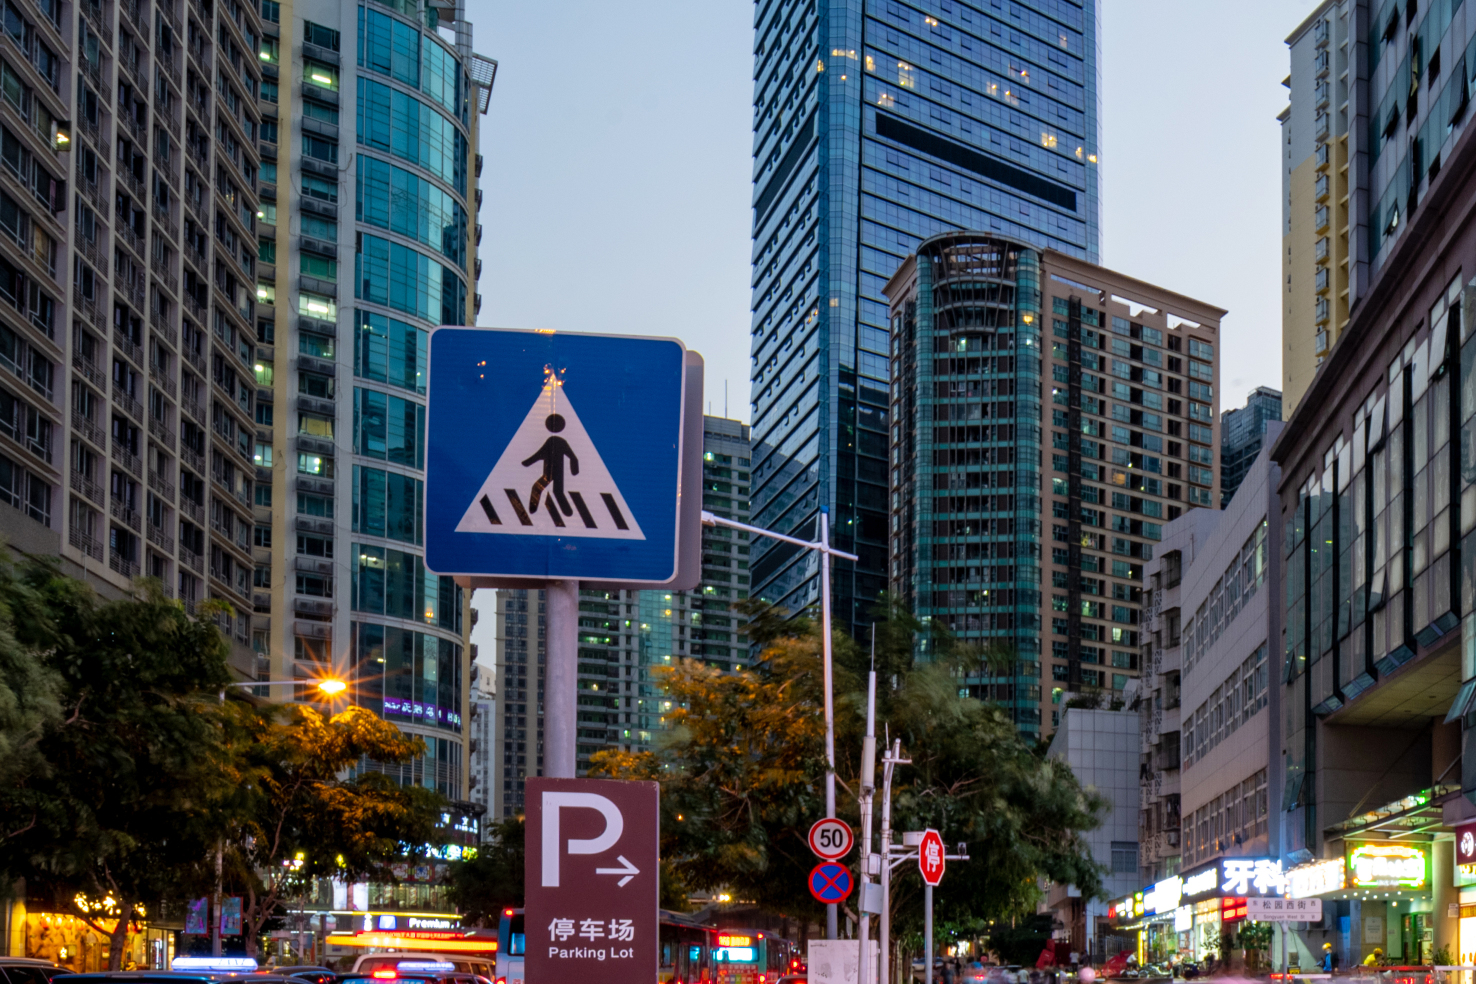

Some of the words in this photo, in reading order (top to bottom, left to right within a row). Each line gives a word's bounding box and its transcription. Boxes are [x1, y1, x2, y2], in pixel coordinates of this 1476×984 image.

[541, 791, 624, 887] P
[819, 828, 844, 848] 50
[925, 838, 940, 872] 停
[1221, 858, 1287, 896] 牙科
[1263, 900, 1306, 910] 松园西街
[408, 918, 451, 928] Premium
[548, 917, 635, 942] 停车场
[548, 947, 606, 961] Parking
[611, 947, 634, 958] Lot
